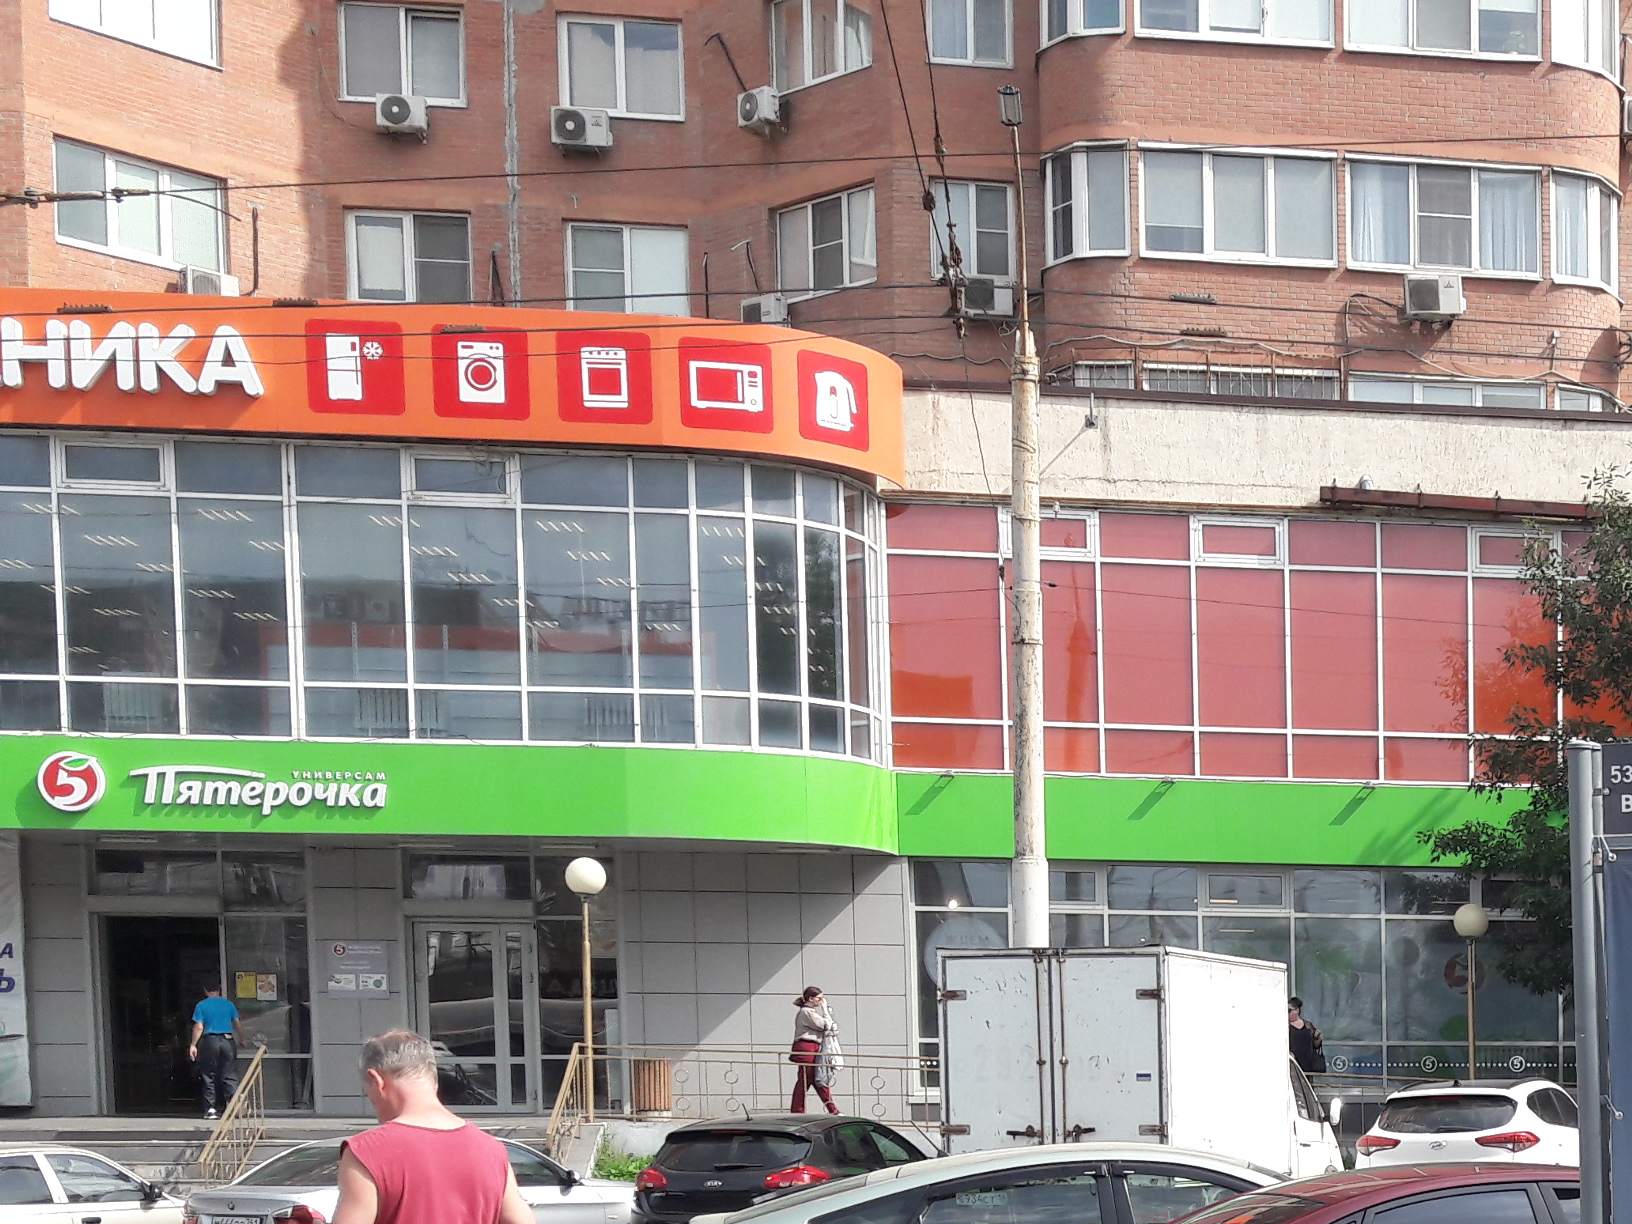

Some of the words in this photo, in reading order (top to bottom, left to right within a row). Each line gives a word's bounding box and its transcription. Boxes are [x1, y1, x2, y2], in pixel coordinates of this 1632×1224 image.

[0, 316, 264, 398] НИКА
[129, 765, 388, 815] Пятерочка
[292, 770, 386, 781] УНИВЕРСАМ
